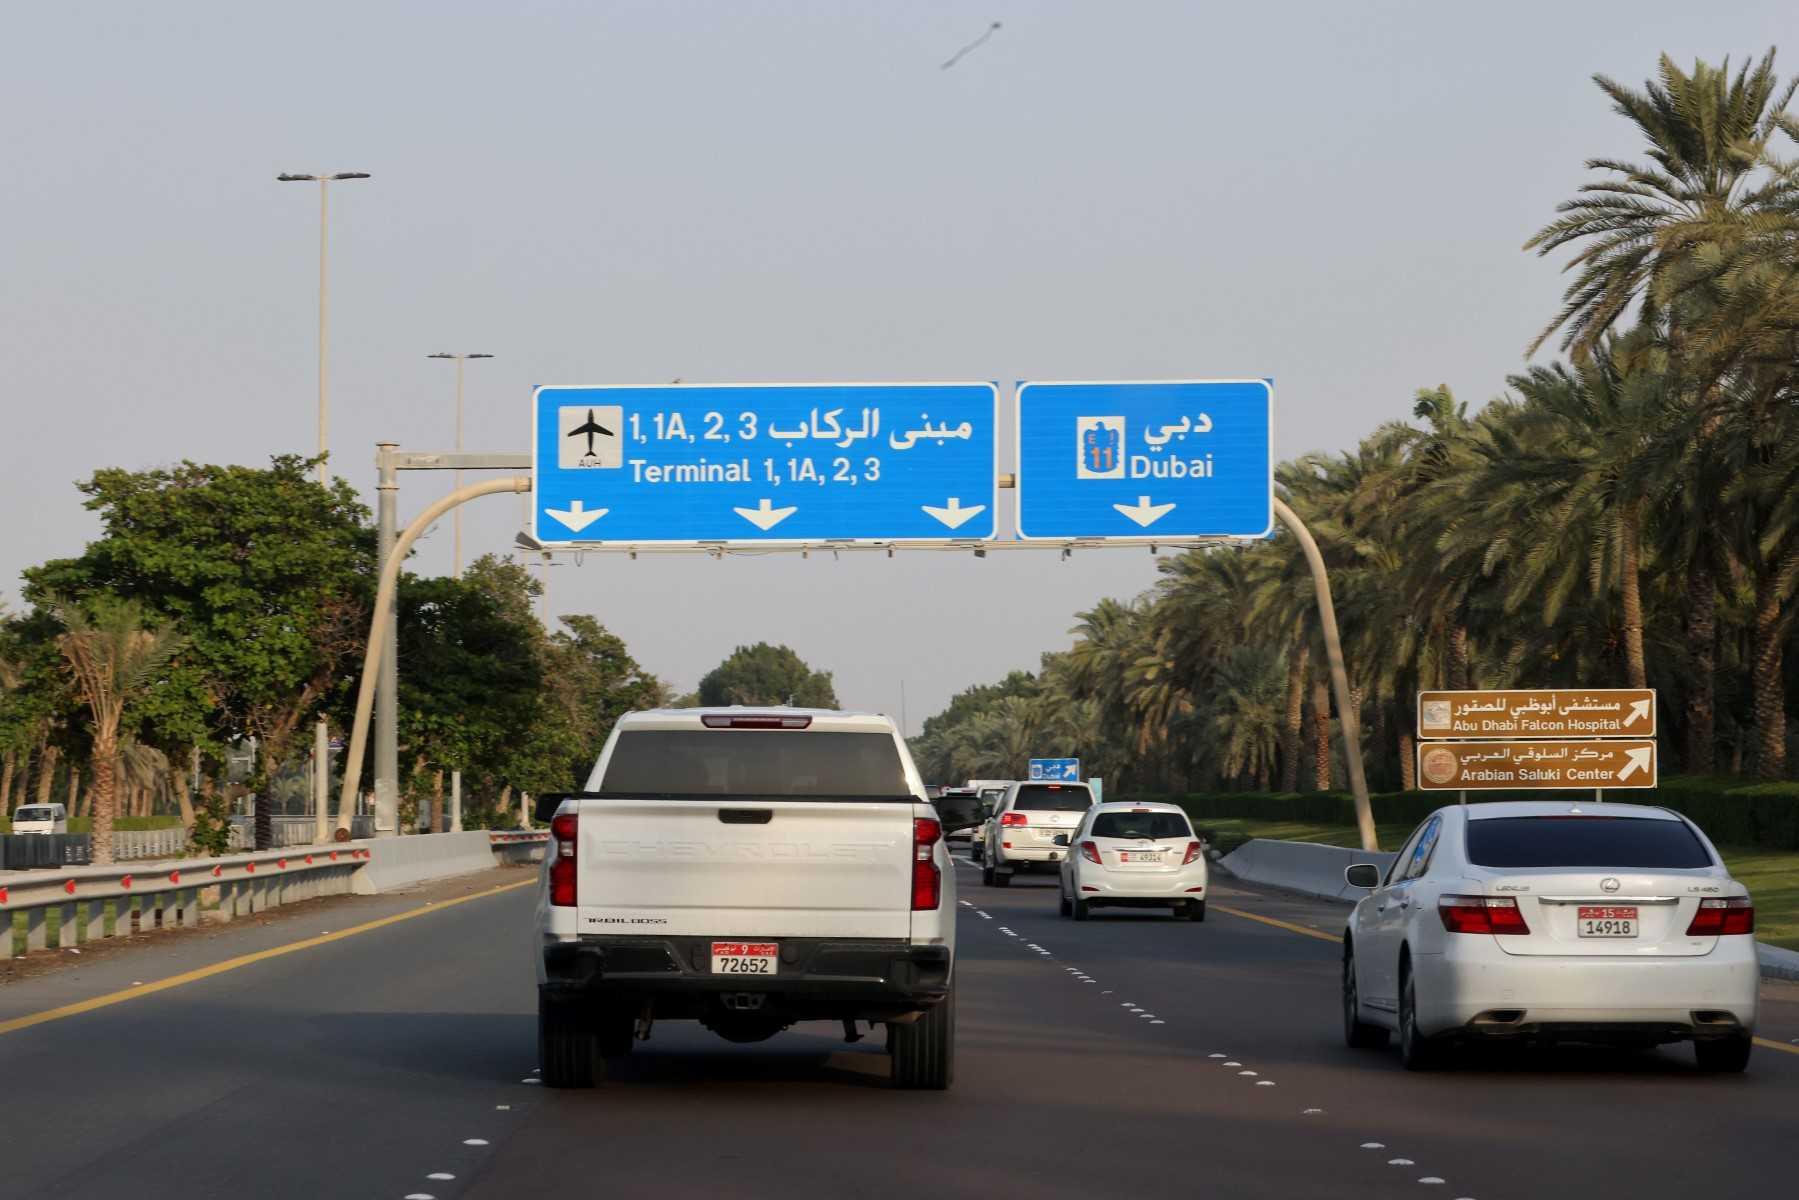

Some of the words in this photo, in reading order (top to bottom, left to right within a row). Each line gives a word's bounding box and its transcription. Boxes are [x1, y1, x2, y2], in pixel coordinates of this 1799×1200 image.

[629, 412, 648, 445] 1,
[653, 412, 696, 444] 1A,
[703, 411, 731, 444] 2,
[738, 411, 758, 440] 3
[768, 407, 880, 449] الركاب
[889, 412, 973, 450] مبنى
[1143, 411, 1214, 453] دبي
[1091, 446, 1113, 468] 11
[1130, 453, 1214, 479] Dubai
[628, 458, 752, 484] Terminal
[763, 457, 781, 487] 1,
[787, 457, 826, 487] 1A,
[832, 456, 858, 487] 2,
[864, 456, 881, 481] 3
[1453, 697, 1507, 717] للصقور
[1558, 696, 1621, 716] مستشفى
[1453, 720, 1478, 731] Abu
[1481, 719, 1519, 731] Dhabi
[1520, 719, 1565, 731] Falcon
[1567, 718, 1621, 733] Hospital
[1460, 747, 1511, 766] العربي
[1512, 746, 1568, 765] السلوقي
[1571, 747, 1614, 762] مركز
[1460, 768, 1515, 781] Arabian
[1518, 768, 1561, 781] Saluki
[1566, 767, 1615, 780] Center
[598, 840, 897, 862] CHEVROLET
[1602, 908, 1616, 918] 15
[1586, 920, 1631, 935] 14918
[741, 944, 749, 955] 9
[720, 957, 769, 973] 72652
